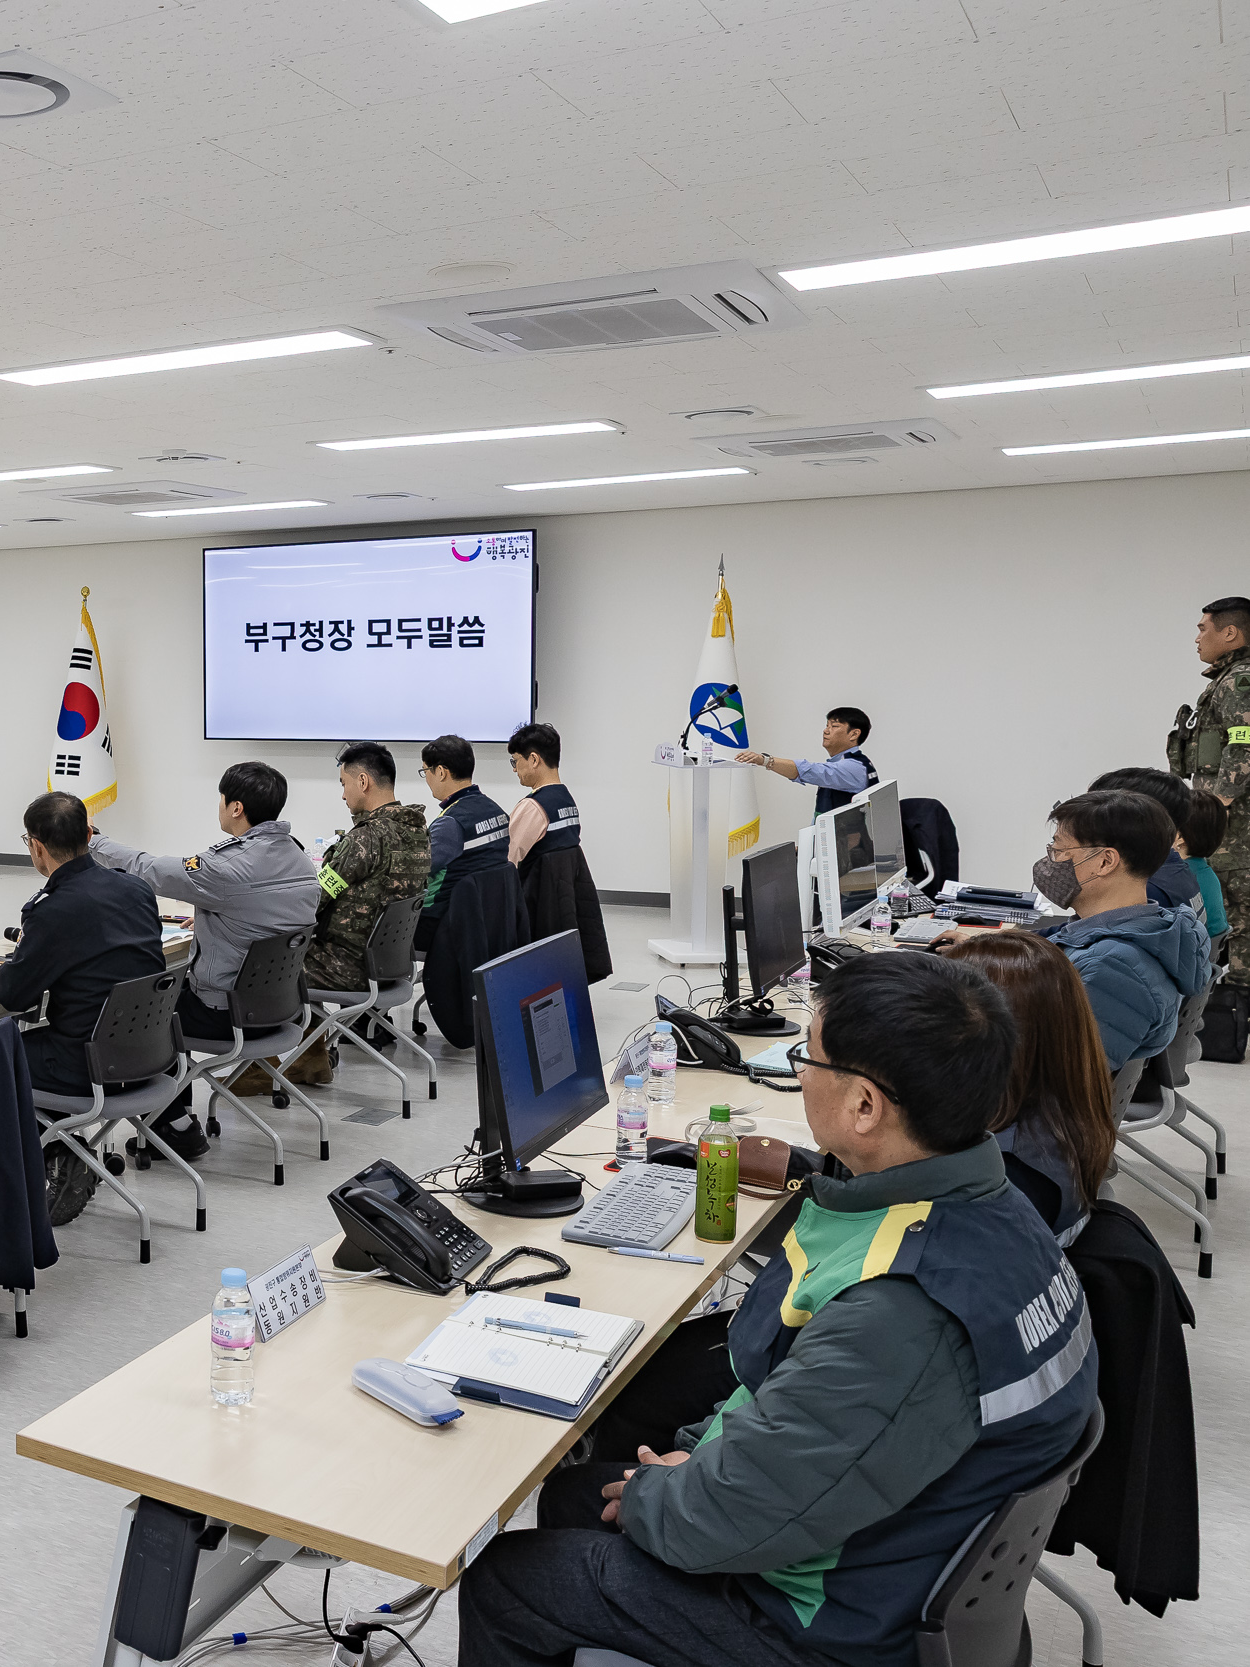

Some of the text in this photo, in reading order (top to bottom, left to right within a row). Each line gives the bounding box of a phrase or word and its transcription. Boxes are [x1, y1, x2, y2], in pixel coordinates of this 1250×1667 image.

[486, 545, 530, 560] 행복광진
[244, 615, 486, 652] 부구청장 모두말씀
[1015, 1293, 1060, 1355] KOREA
